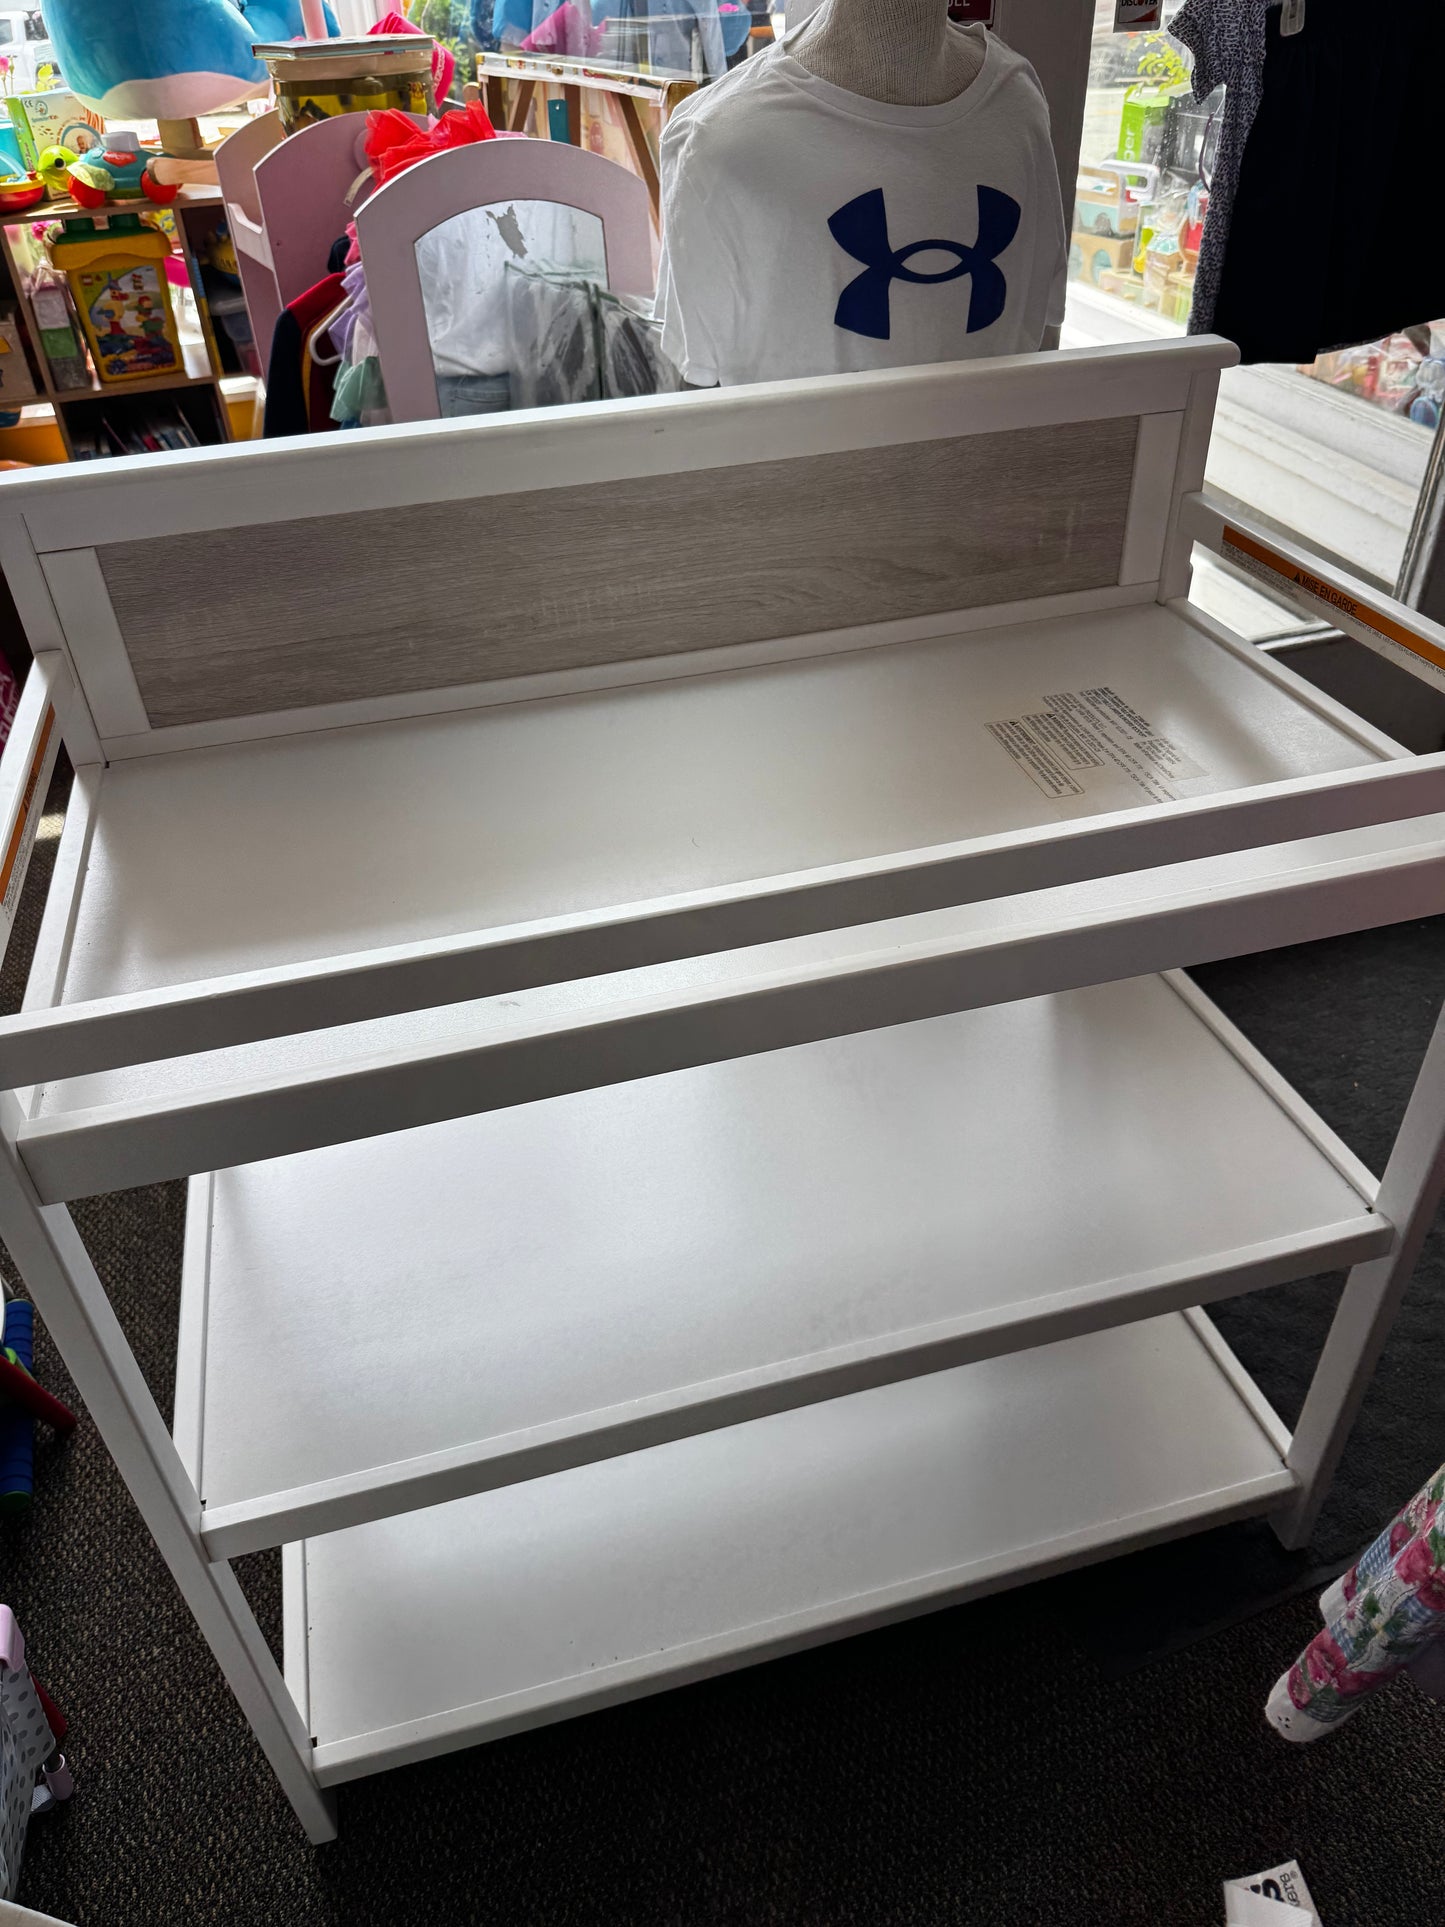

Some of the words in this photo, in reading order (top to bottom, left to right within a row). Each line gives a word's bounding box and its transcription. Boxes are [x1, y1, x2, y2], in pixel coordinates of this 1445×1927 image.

[1300, 575, 1320, 594] MISE
[1320, 585, 1331, 602] EN
[1331, 592, 1358, 616] GARDE
